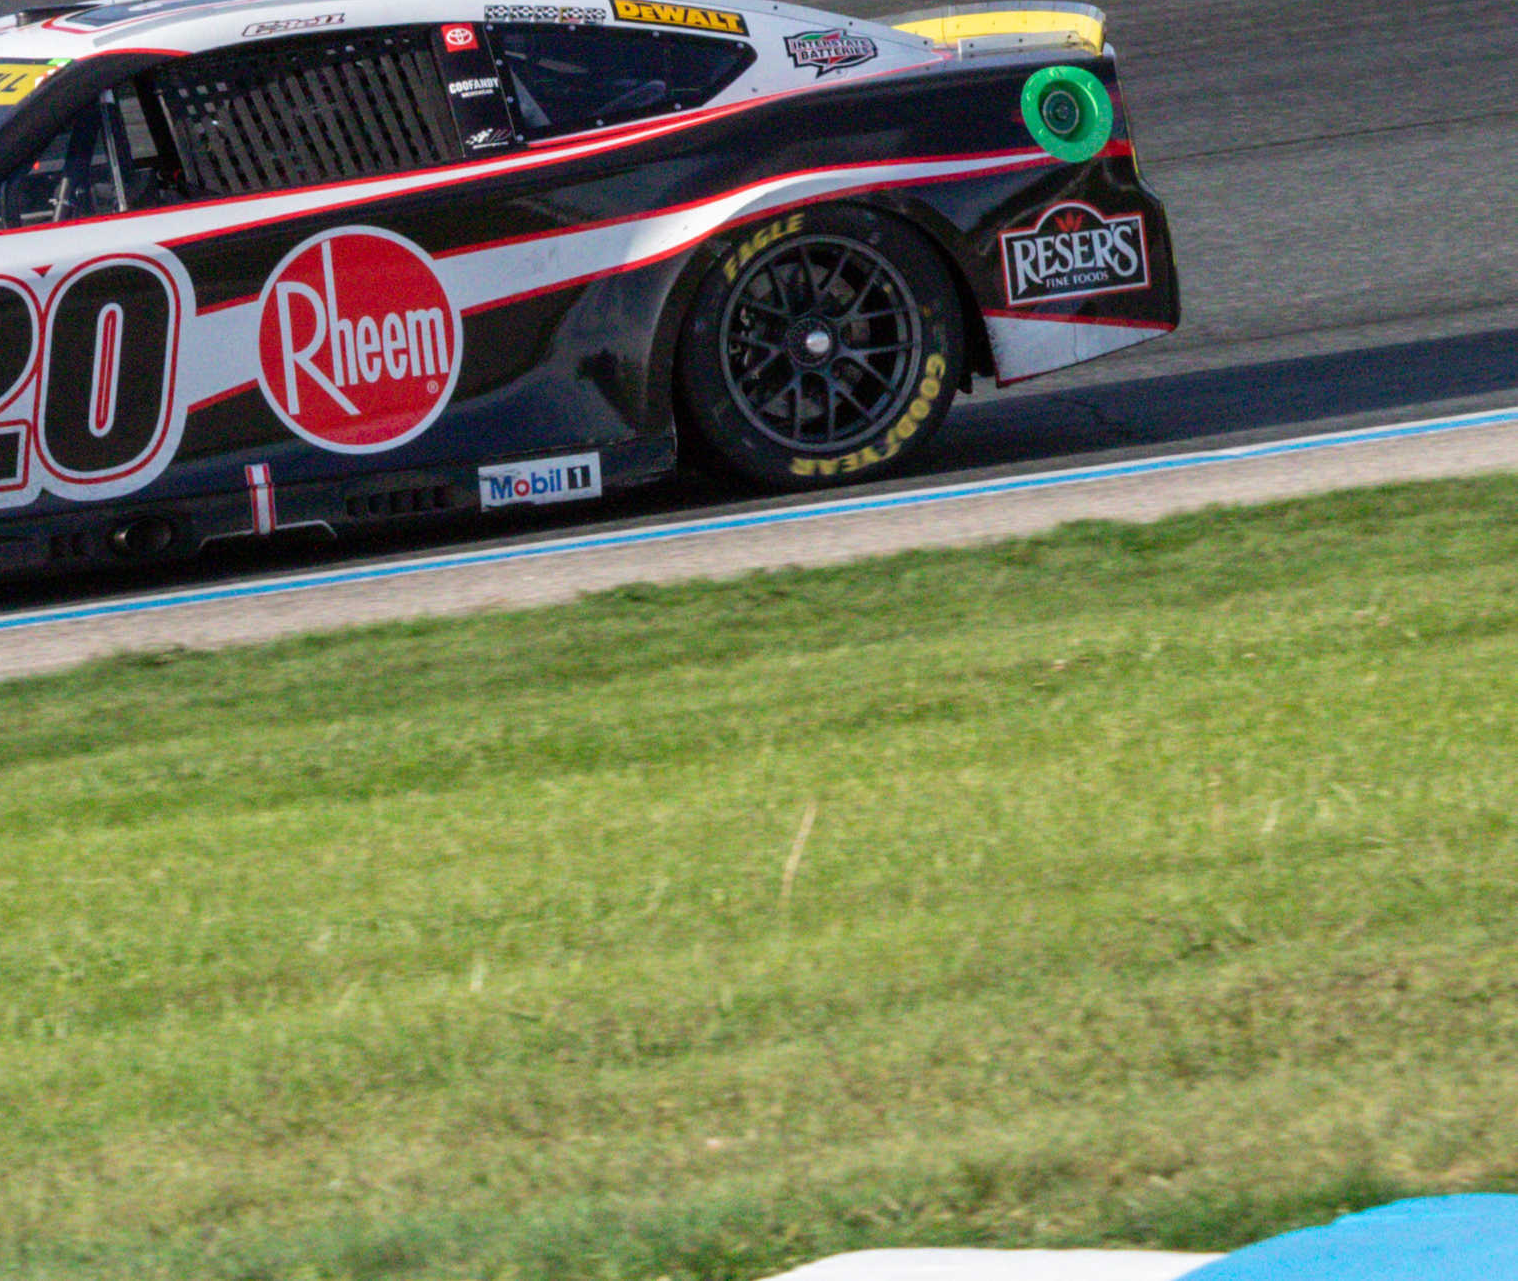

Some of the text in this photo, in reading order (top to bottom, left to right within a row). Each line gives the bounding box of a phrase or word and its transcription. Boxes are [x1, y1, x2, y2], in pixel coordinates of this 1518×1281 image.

[723, 212, 805, 285] EAGLE
[1011, 222, 1139, 296] RESER'S
[1045, 270, 1110, 289] FINE FOODS
[275, 239, 449, 417] Rheem
[788, 352, 947, 477] GOODYEAR
[489, 468, 563, 501] Mobil
